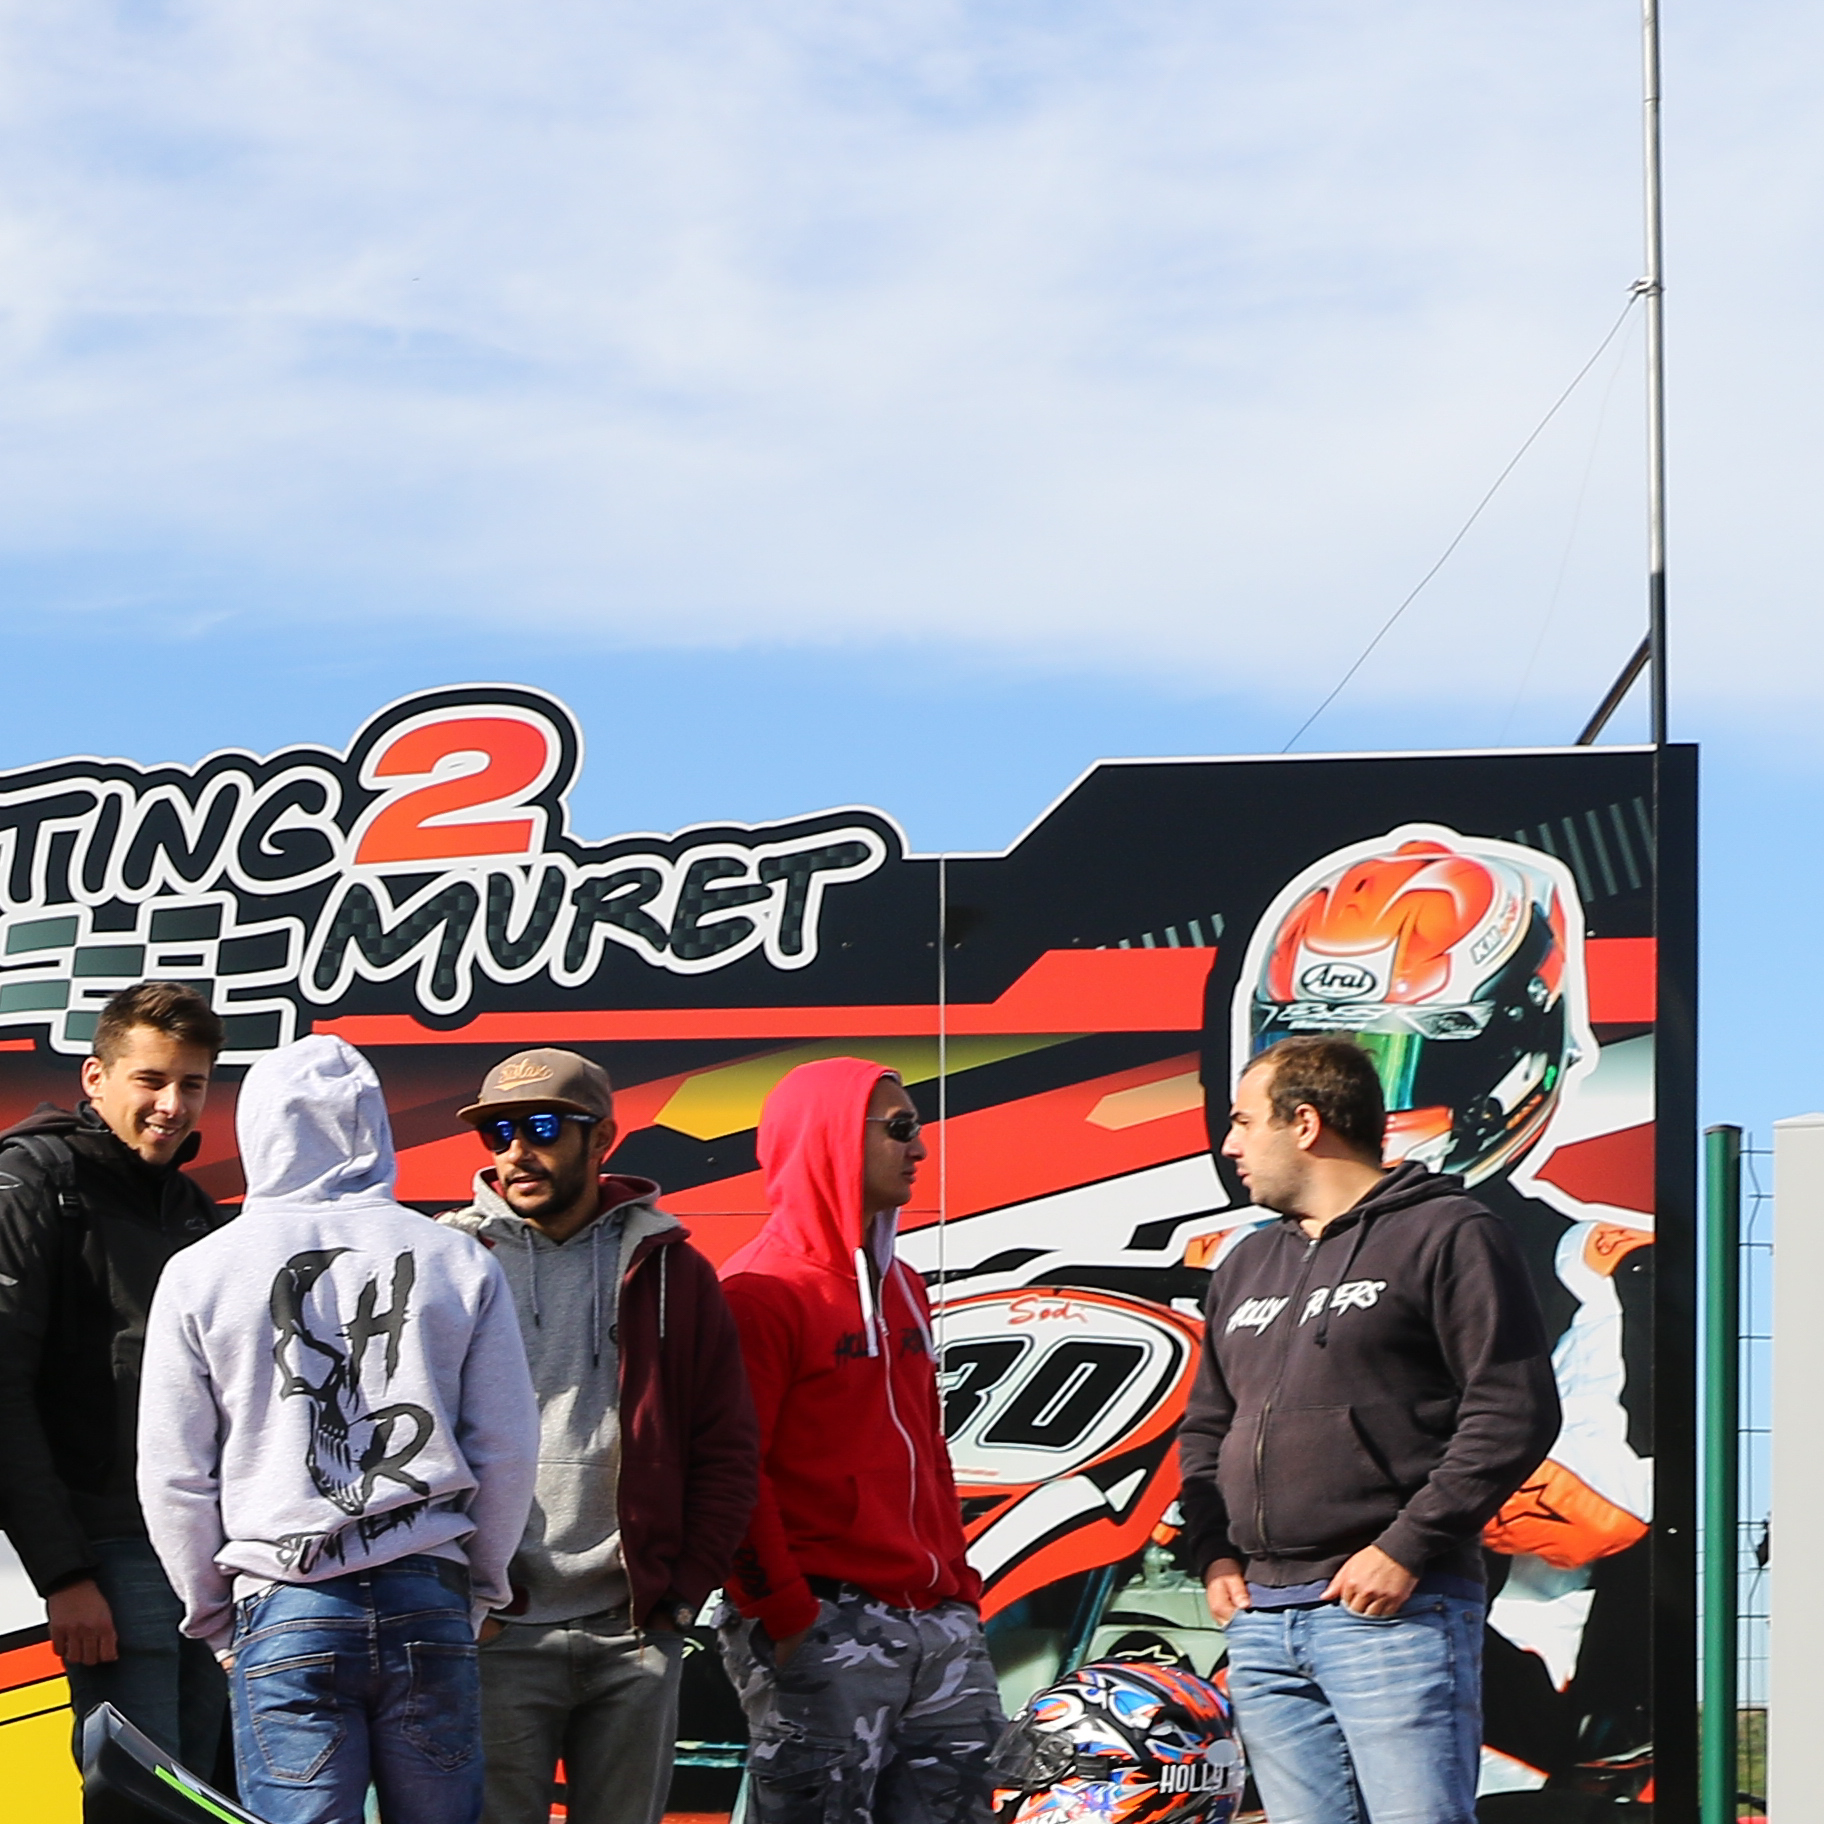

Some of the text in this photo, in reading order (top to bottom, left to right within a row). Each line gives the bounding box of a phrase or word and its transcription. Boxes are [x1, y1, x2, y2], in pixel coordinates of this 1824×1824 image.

[350, 712, 552, 867] 2
[302, 828, 884, 1014] MURET
[1314, 966, 1366, 988] Arai
[1007, 1294, 1092, 1325] Sodi
